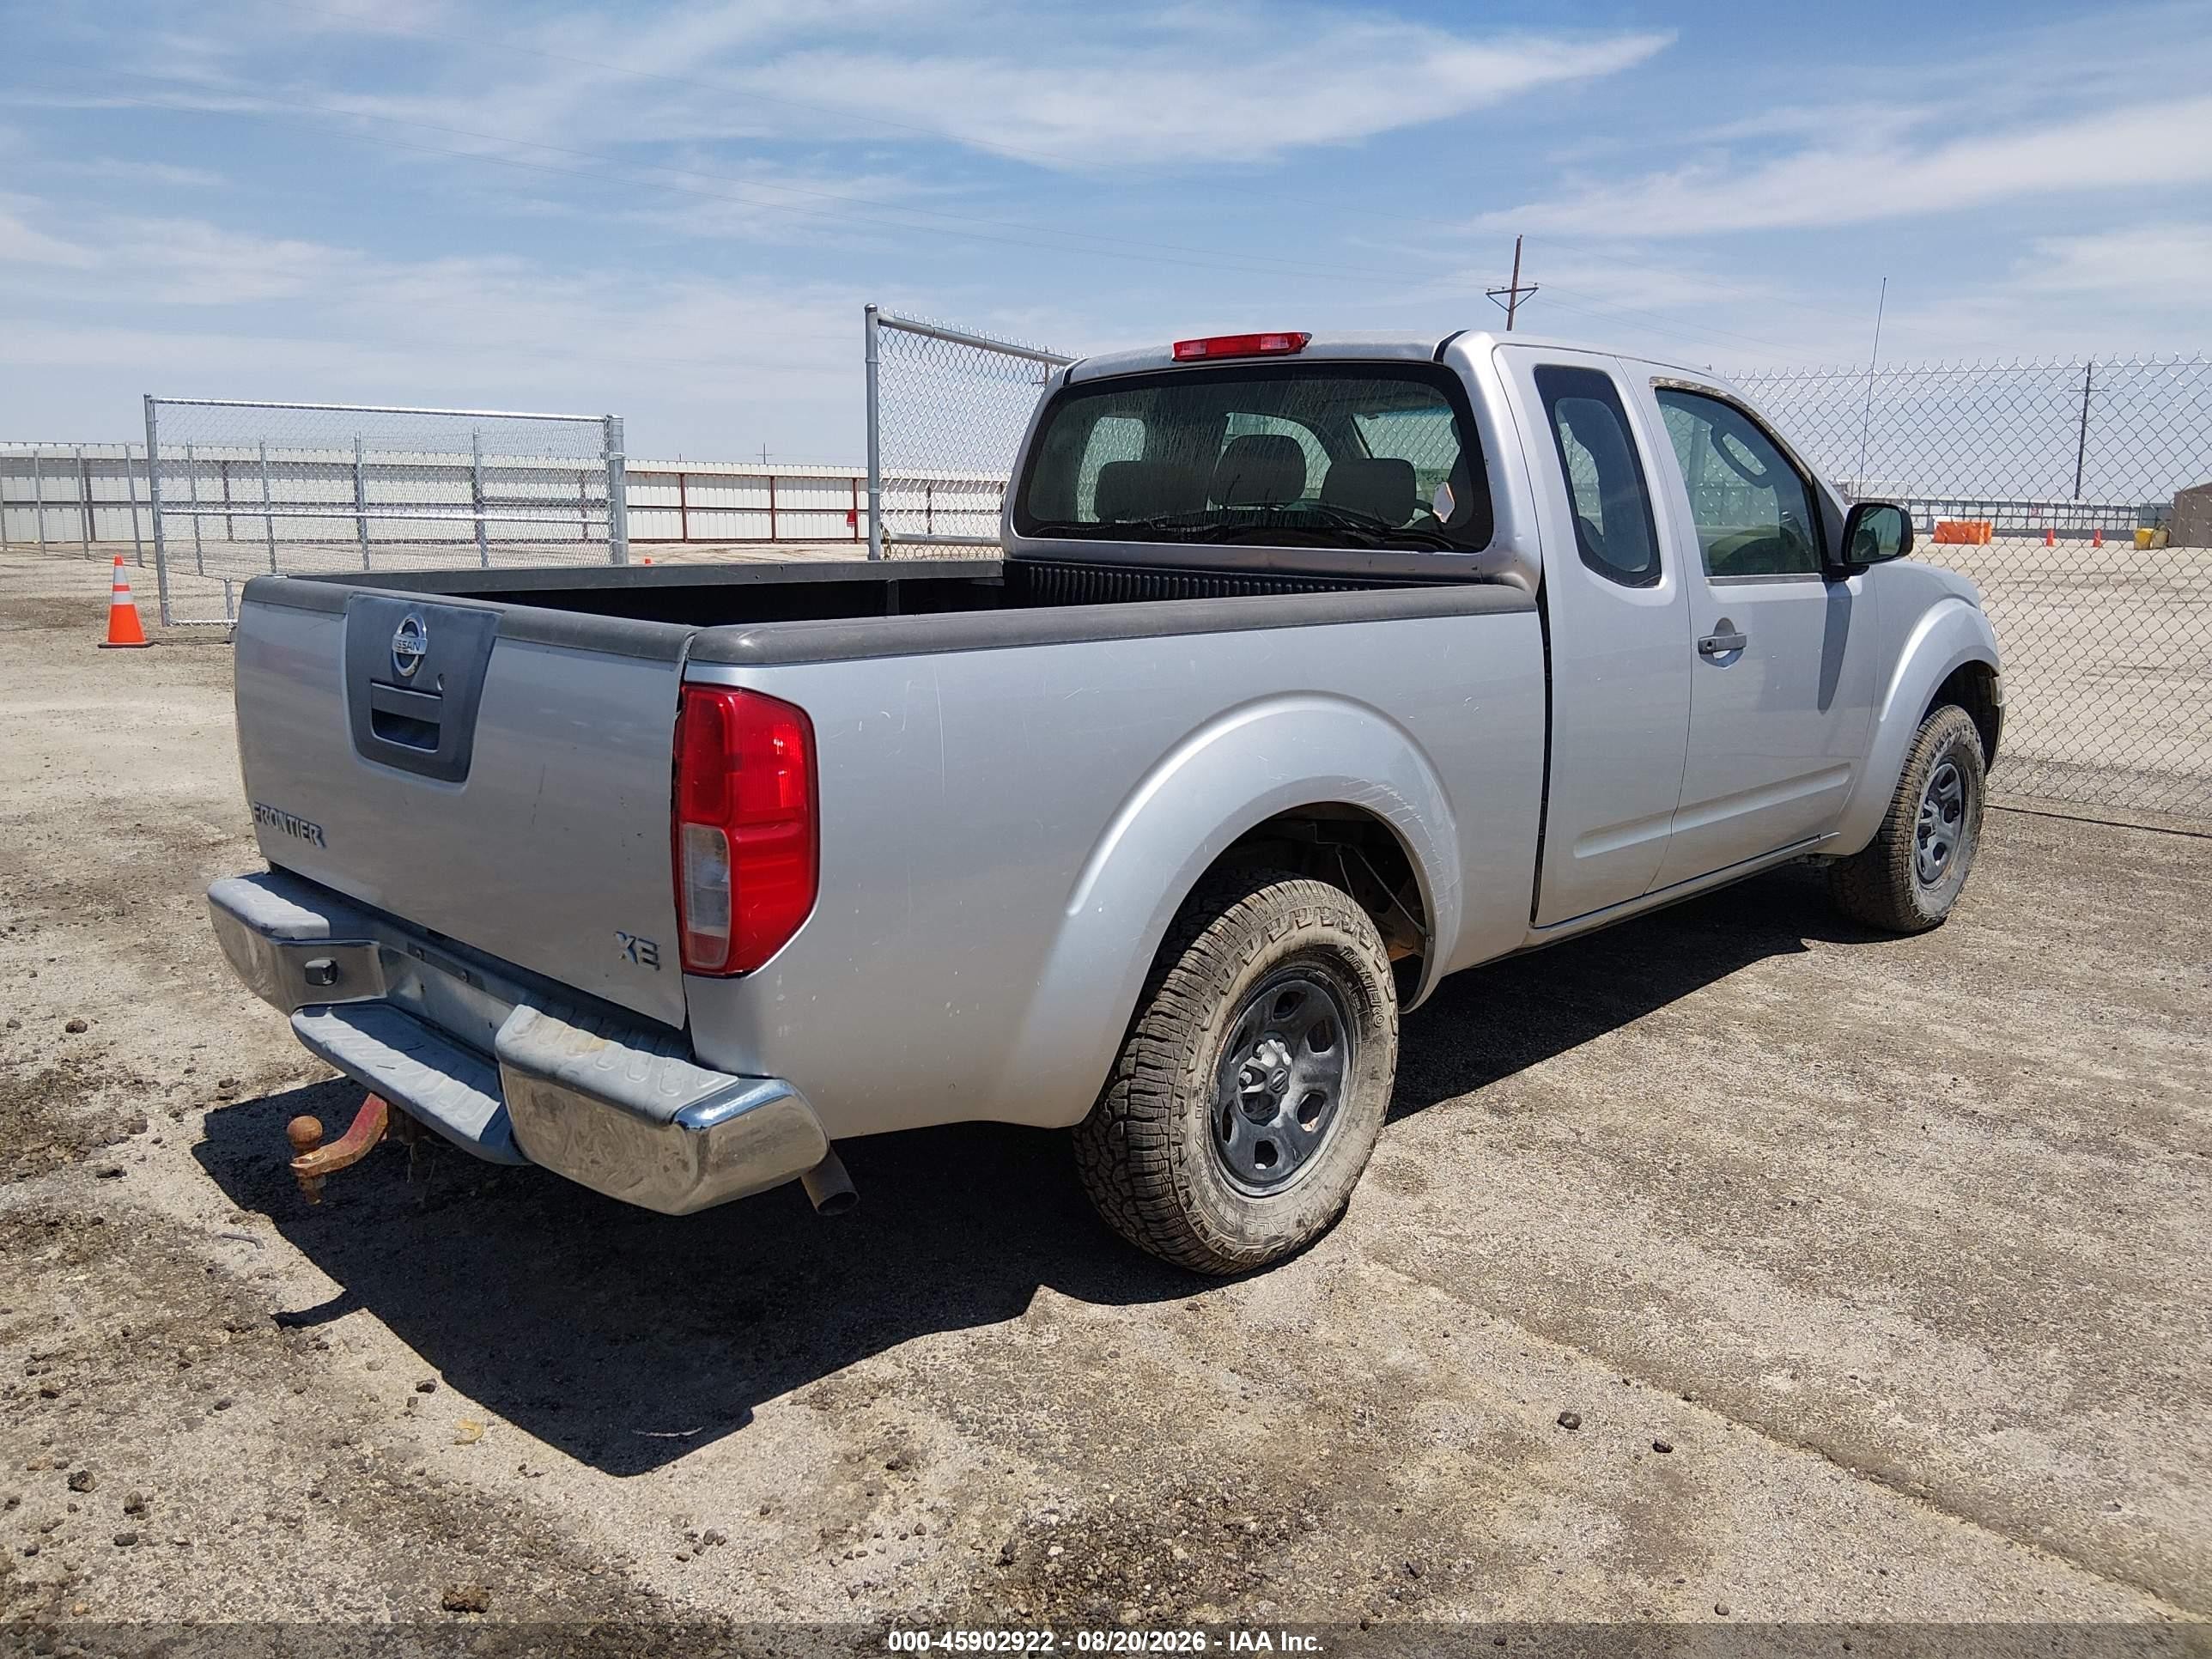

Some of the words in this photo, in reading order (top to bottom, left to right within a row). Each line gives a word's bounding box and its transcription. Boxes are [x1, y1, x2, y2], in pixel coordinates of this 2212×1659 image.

[393, 639, 421, 651] SSAN
[253, 800, 326, 848] FRONTIER
[615, 930, 660, 971] XE
[1340, 945, 1385, 1028] DEXTERO
